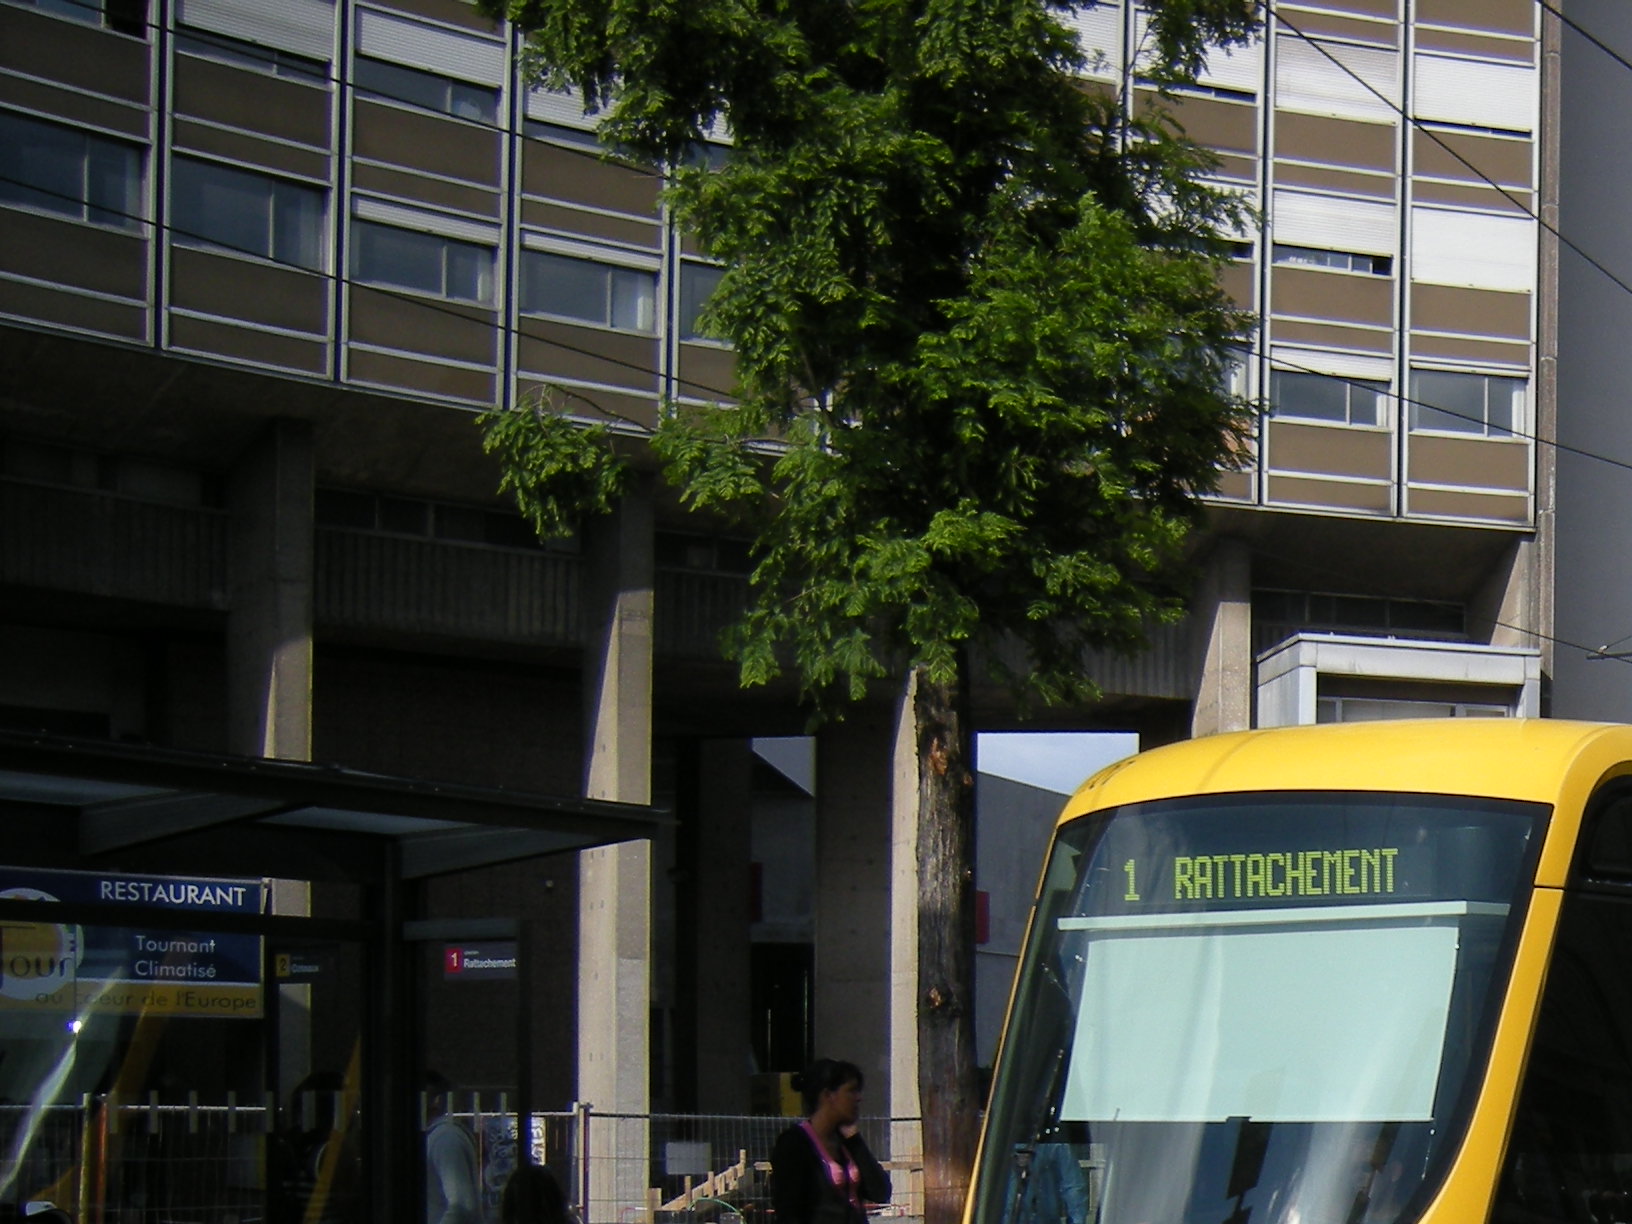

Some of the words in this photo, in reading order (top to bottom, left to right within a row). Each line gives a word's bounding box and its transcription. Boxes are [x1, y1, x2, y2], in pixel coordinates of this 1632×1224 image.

[1123, 859, 1140, 902] 1
[1174, 848, 1398, 900] RATTACHEMENT
[100, 880, 247, 907] RESTAURANT
[136, 935, 216, 954] Tournant
[134, 960, 217, 979] Climatisé
[280, 958, 287, 971] 2
[451, 952, 458, 968] 1
[463, 958, 516, 969] Rattachement
[35, 993, 63, 1006] au
[142, 991, 168, 1007] de
[175, 991, 257, 1011] l'Europe
